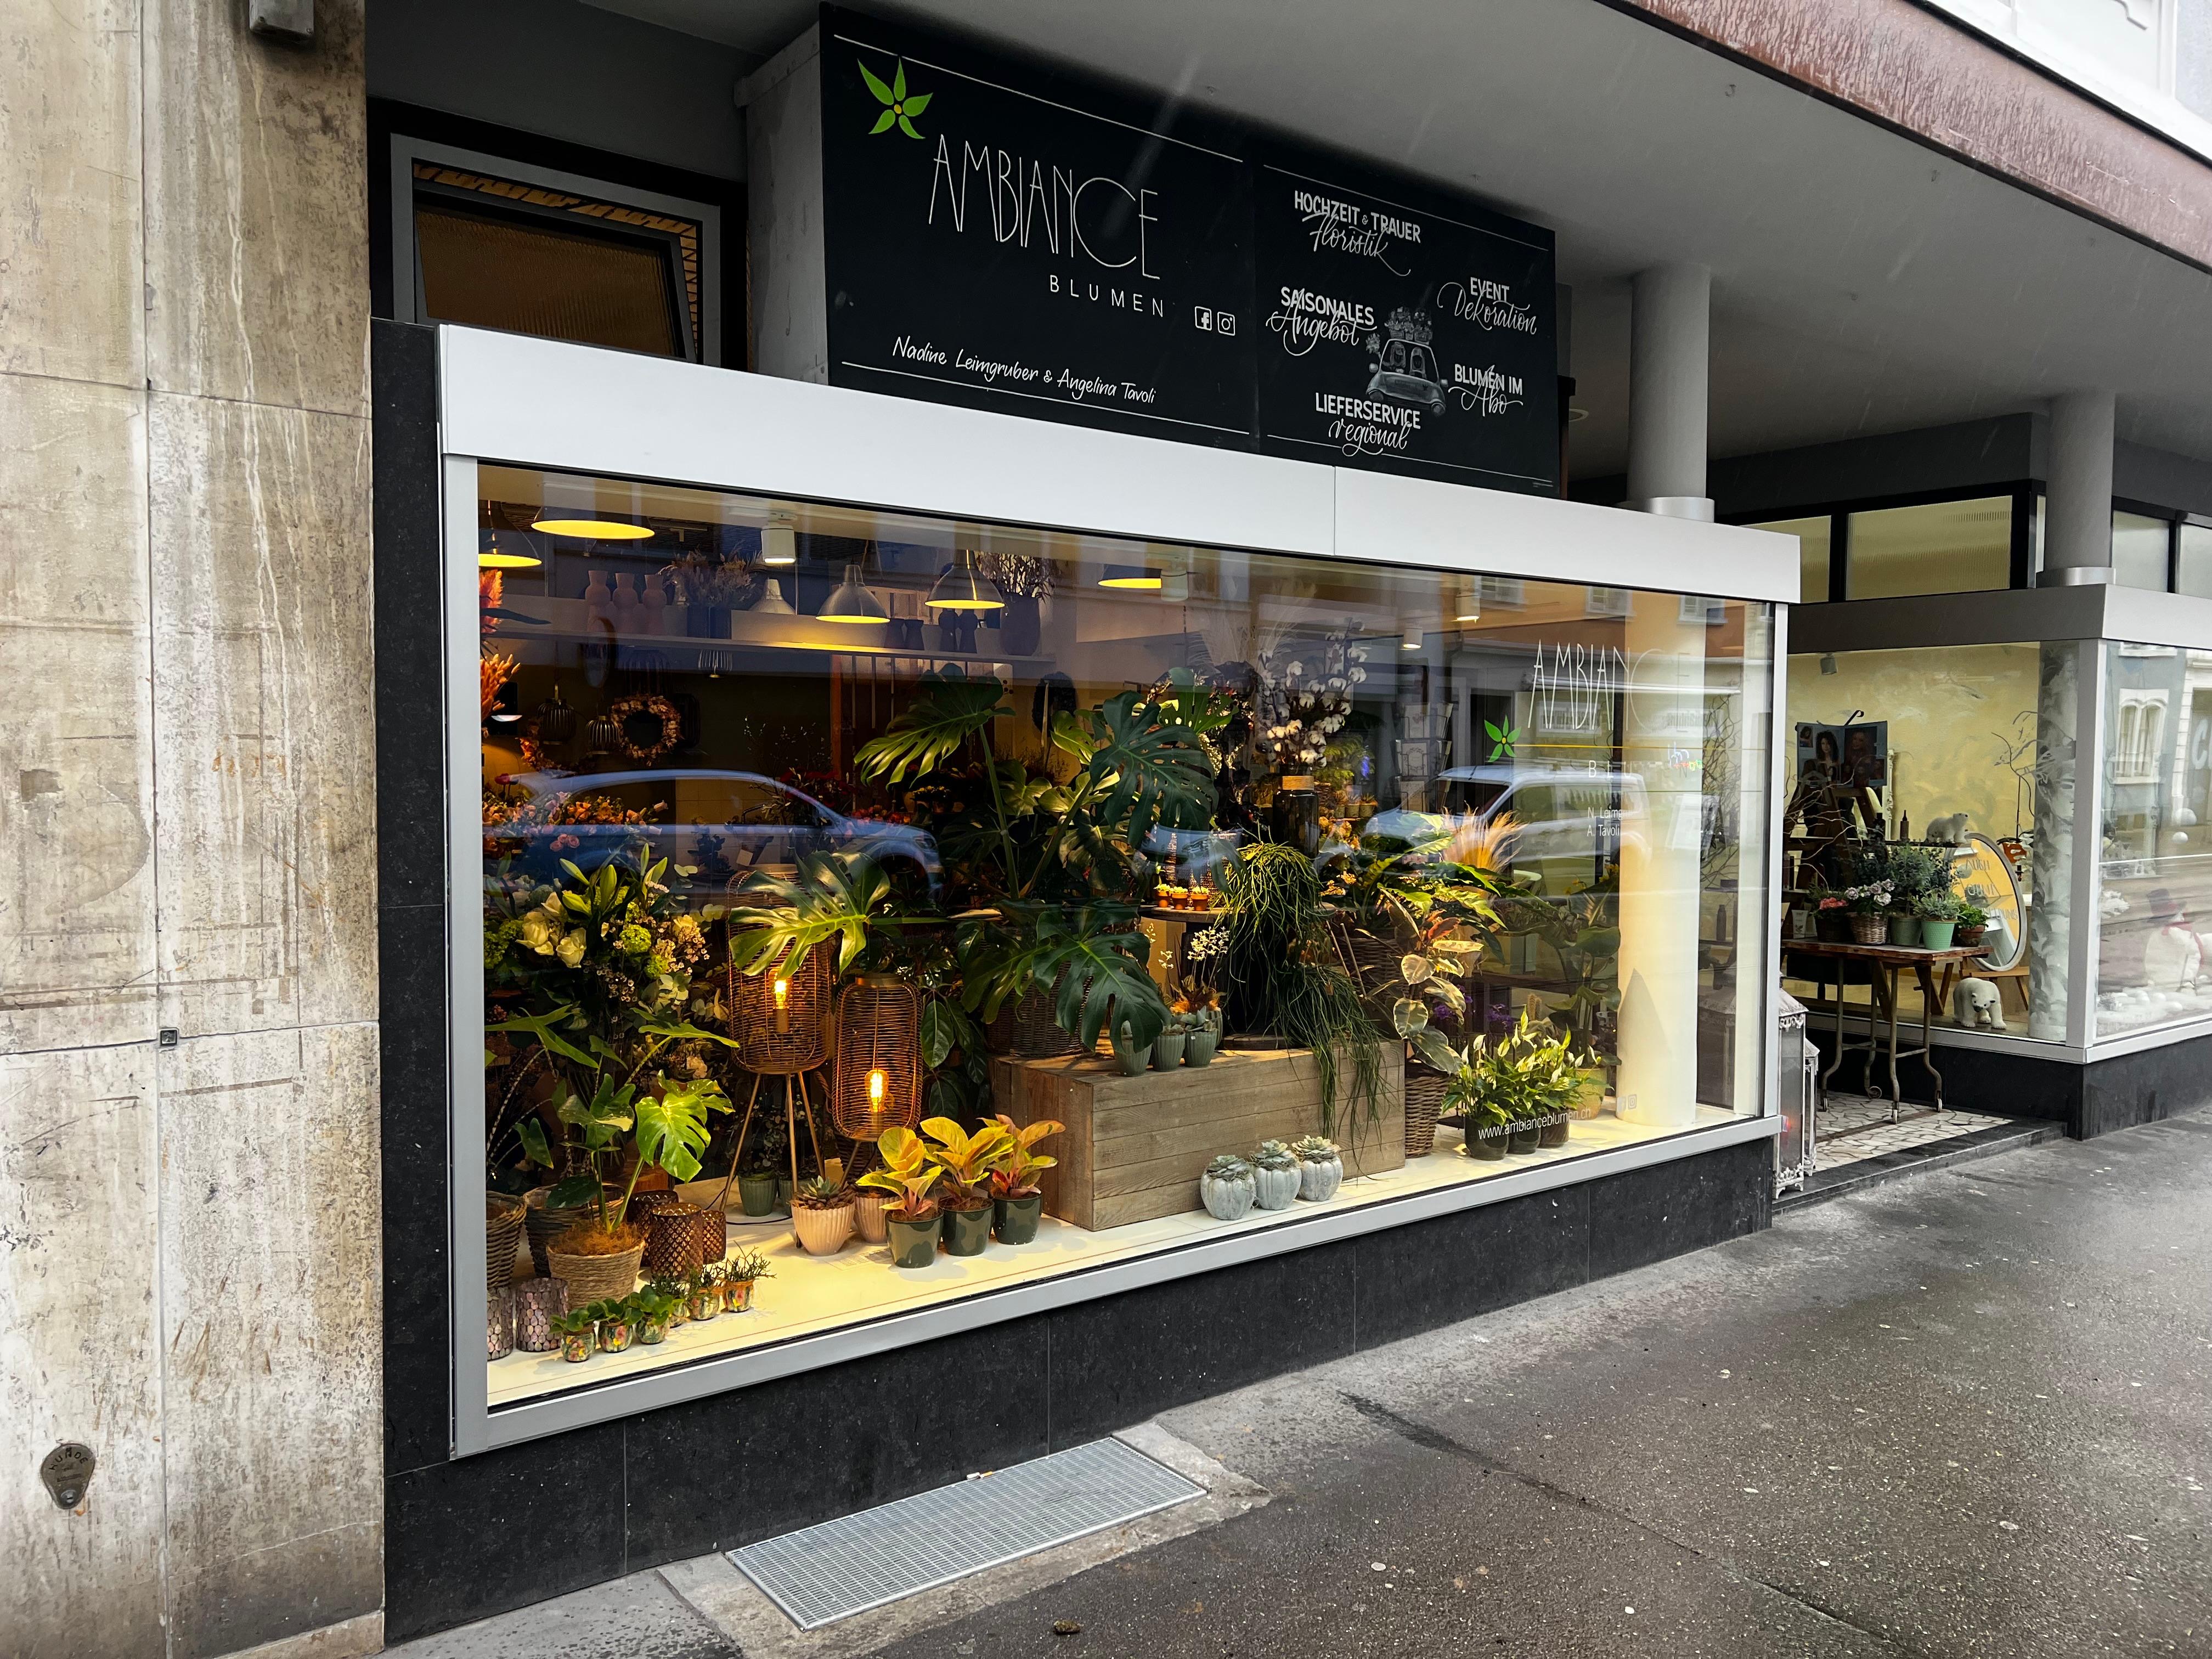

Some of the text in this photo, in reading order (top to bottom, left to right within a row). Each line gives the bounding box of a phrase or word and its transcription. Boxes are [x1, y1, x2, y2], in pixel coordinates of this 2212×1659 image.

[929, 134, 1160, 280] AMBIANCE
[1294, 190, 1421, 243] HOCHZEIT & TRAUER
[1302, 212, 1411, 276] Floristik
[1050, 274, 1163, 317] BLUMEN
[1281, 286, 1374, 325] SAISONALES
[1437, 282, 1537, 335] Dekoration
[1470, 276, 1510, 302] EVENT
[1266, 288, 1377, 356] Angebot
[893, 335, 1156, 403] Nadine Leimgruber & Angelina Tavoli
[1455, 363, 1522, 396] BLUMEN IM
[1316, 392, 1421, 429] LIEFERSERVICE
[1448, 364, 1523, 417] Abo
[1328, 418, 1412, 456] regional
[1598, 824, 1620, 837] Tavoli
[1479, 1107, 1590, 1139] www.ambianceblumen.ch
[48, 1447, 88, 1470] HUNDE
